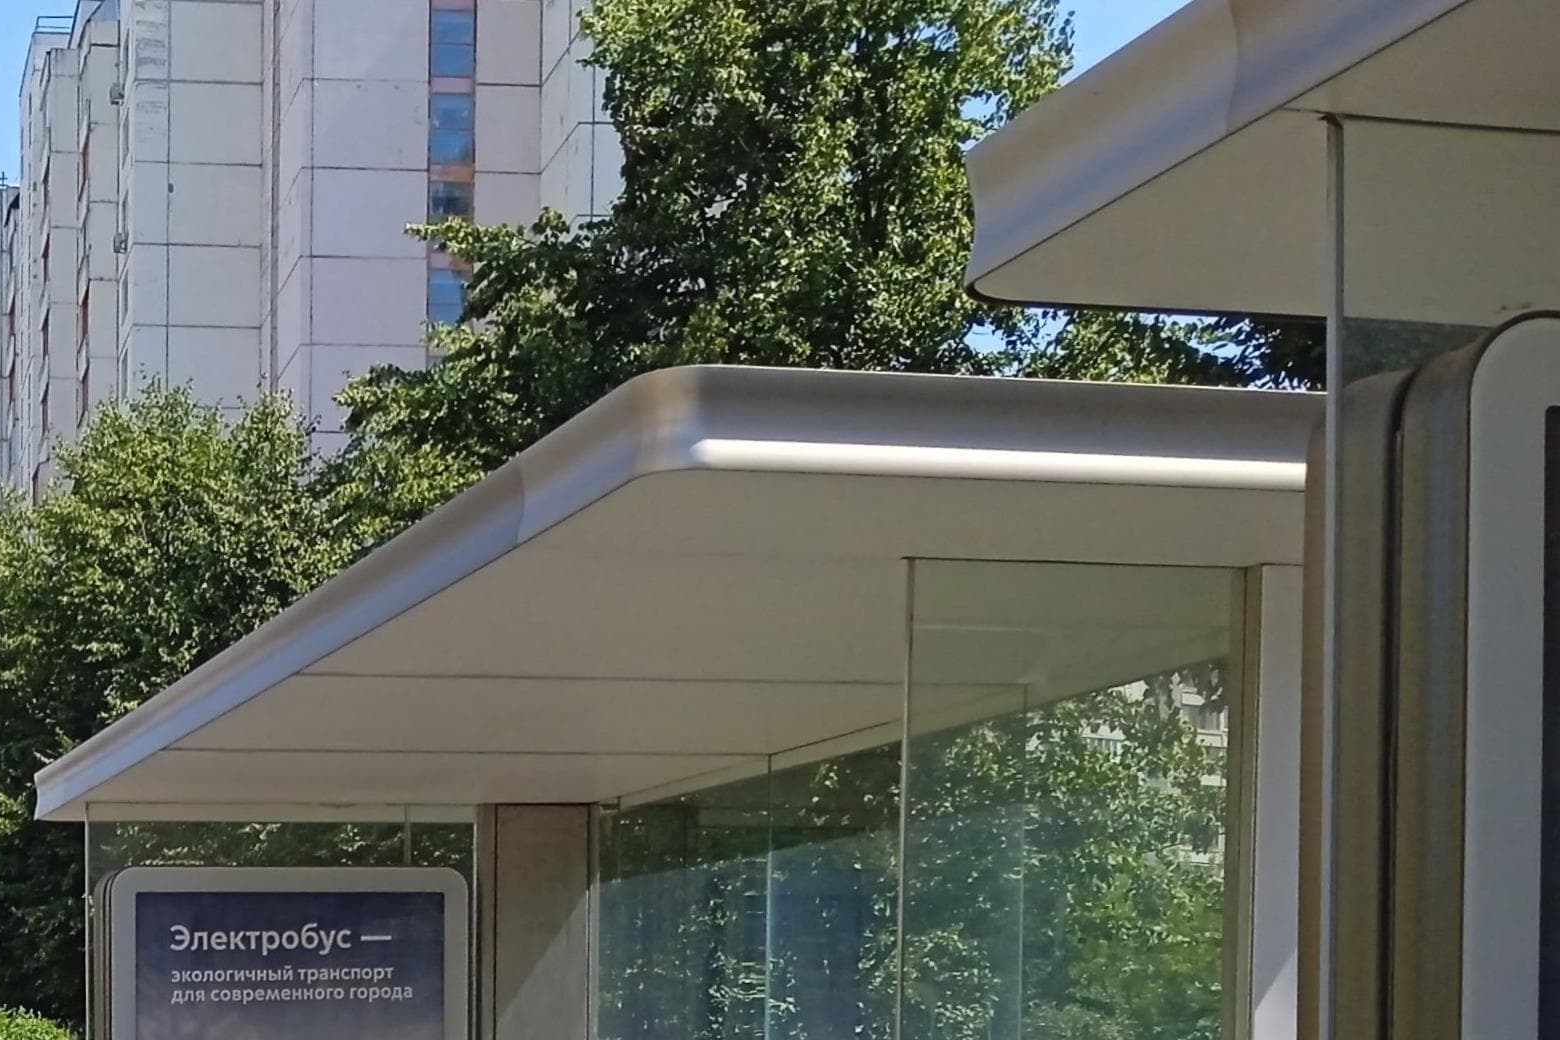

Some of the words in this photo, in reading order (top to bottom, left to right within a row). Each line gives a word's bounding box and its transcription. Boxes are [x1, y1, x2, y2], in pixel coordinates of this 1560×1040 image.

[169, 923, 352, 956] Электробус
[170, 965, 294, 983] экологичный
[297, 966, 395, 984] транспорт
[170, 988, 206, 1005] для
[210, 986, 345, 1005] современного
[349, 984, 414, 1003] города
